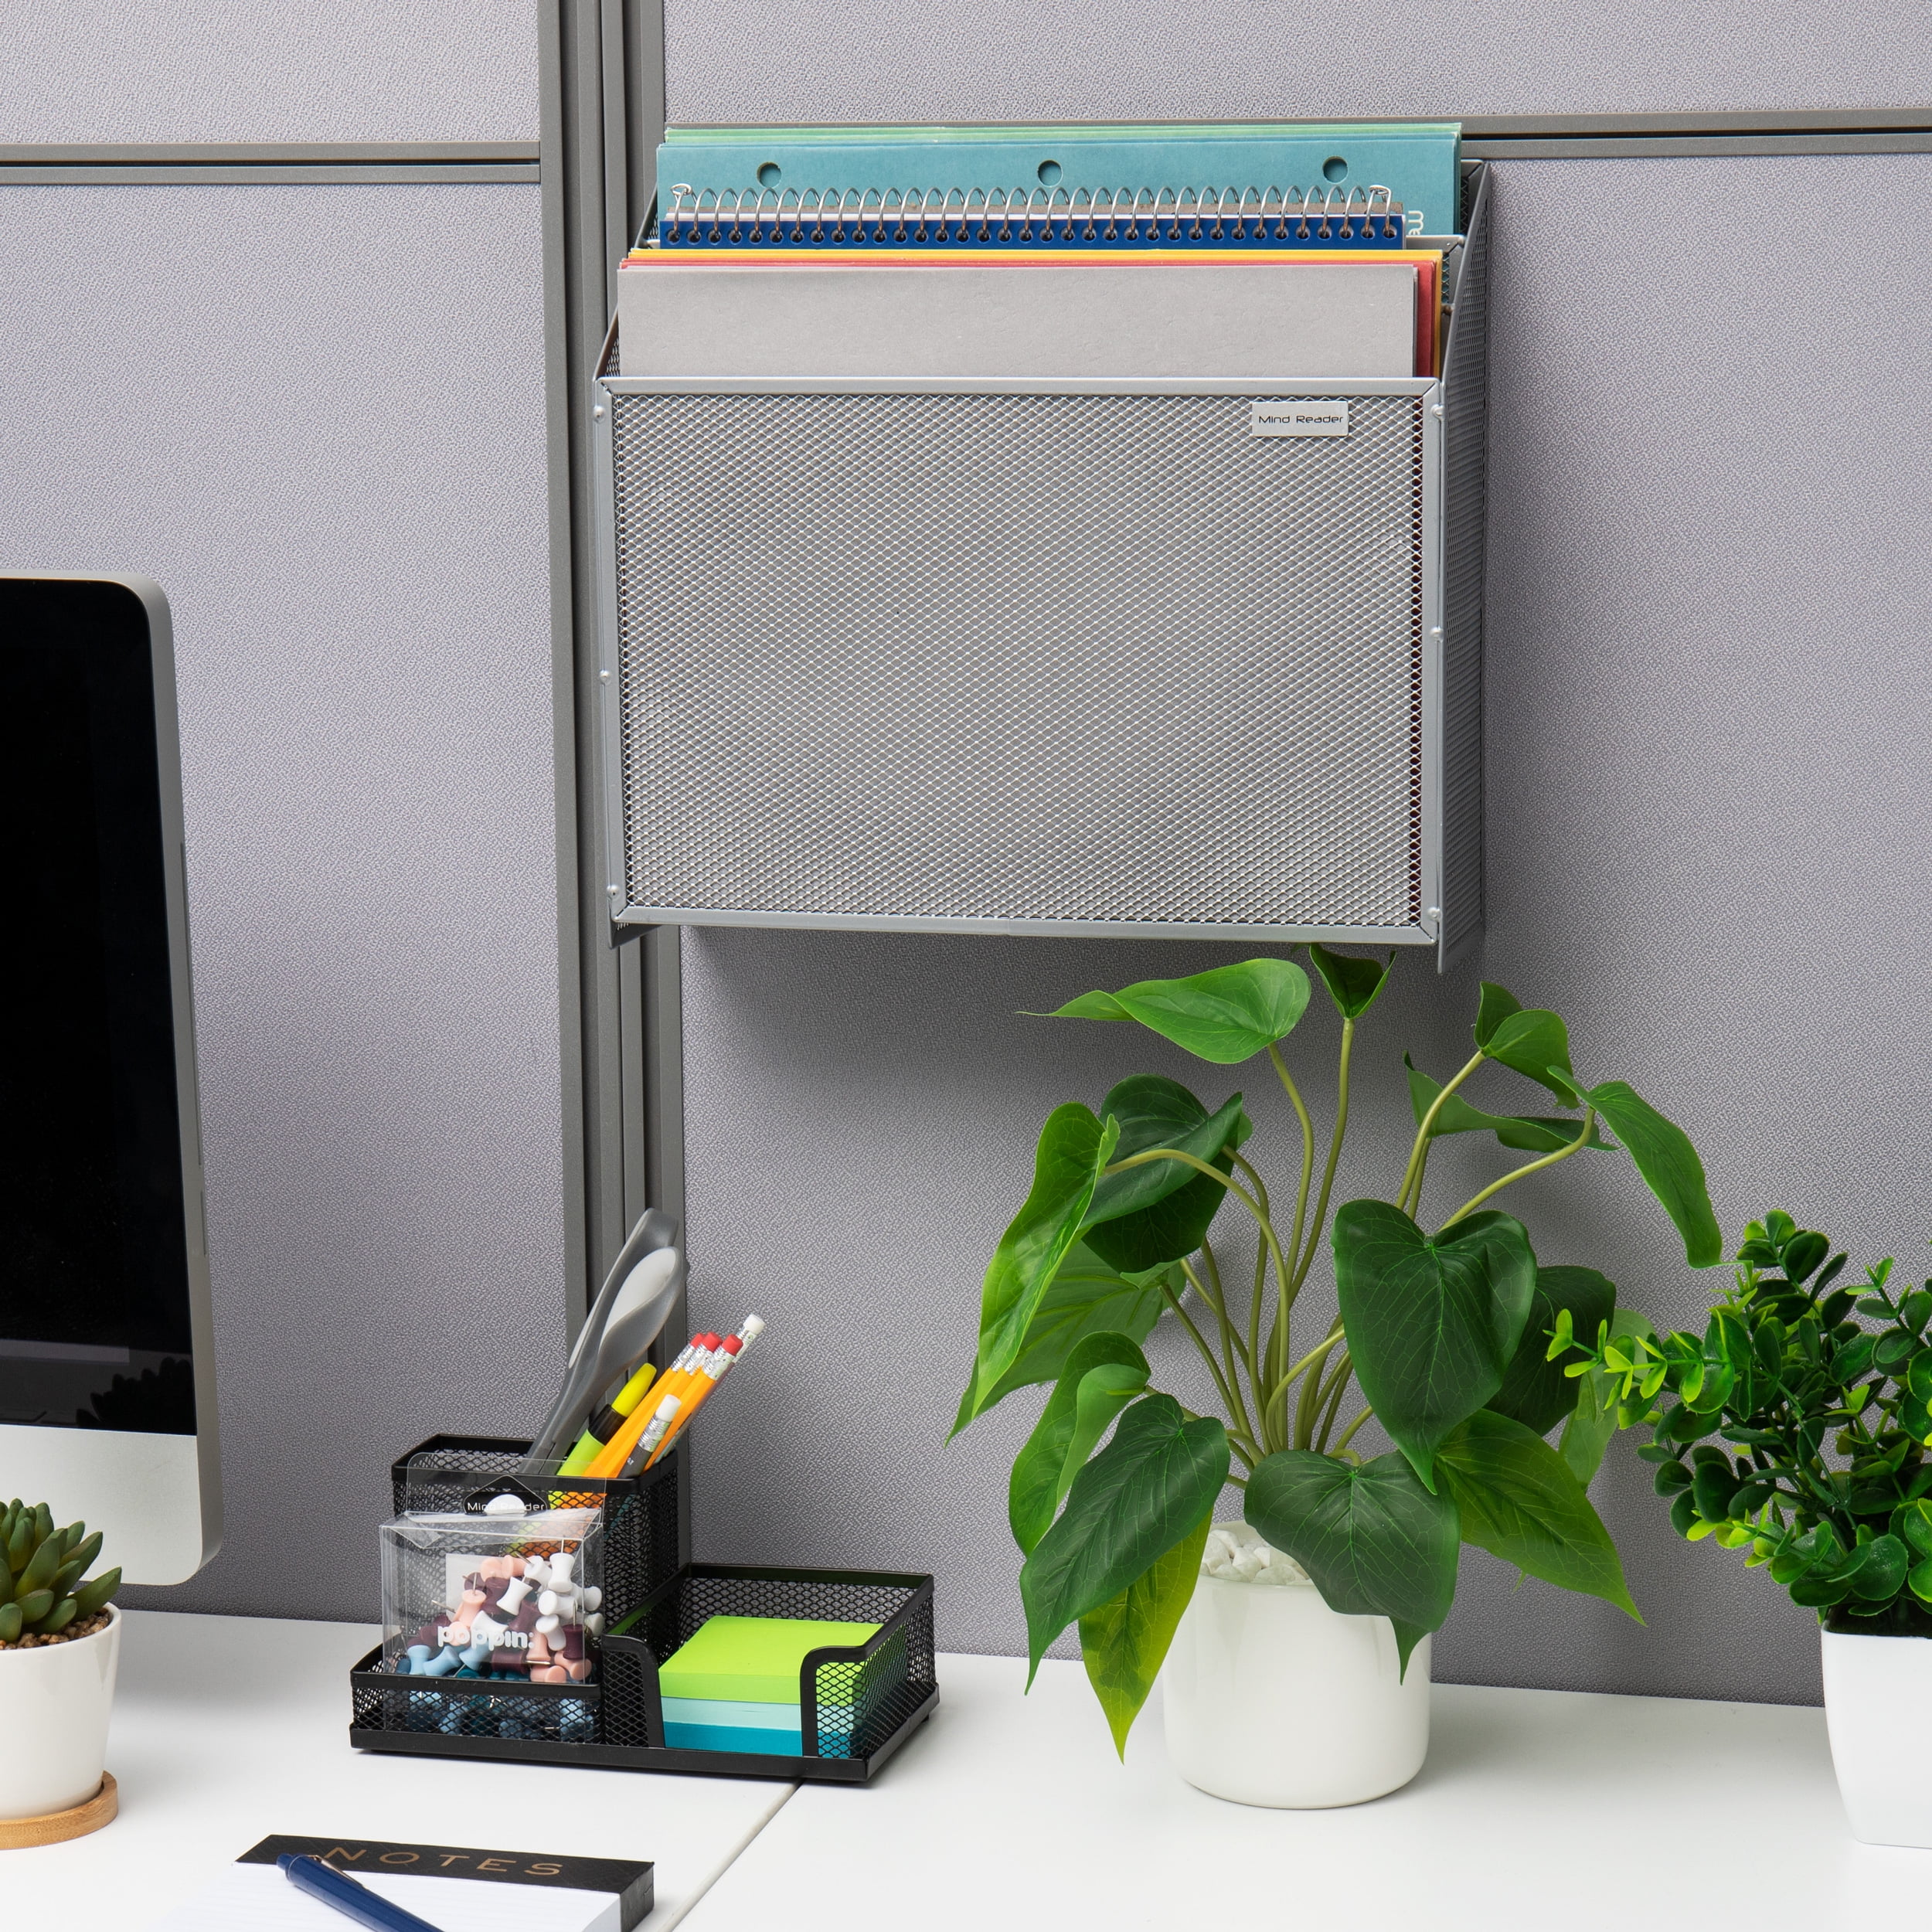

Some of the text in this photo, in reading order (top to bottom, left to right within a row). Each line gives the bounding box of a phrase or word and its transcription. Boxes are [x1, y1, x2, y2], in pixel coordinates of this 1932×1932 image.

[1258, 415, 1343, 423] Mind Reader
[468, 1502, 495, 1511] Min
[323, 1846, 563, 1876] NOTES
